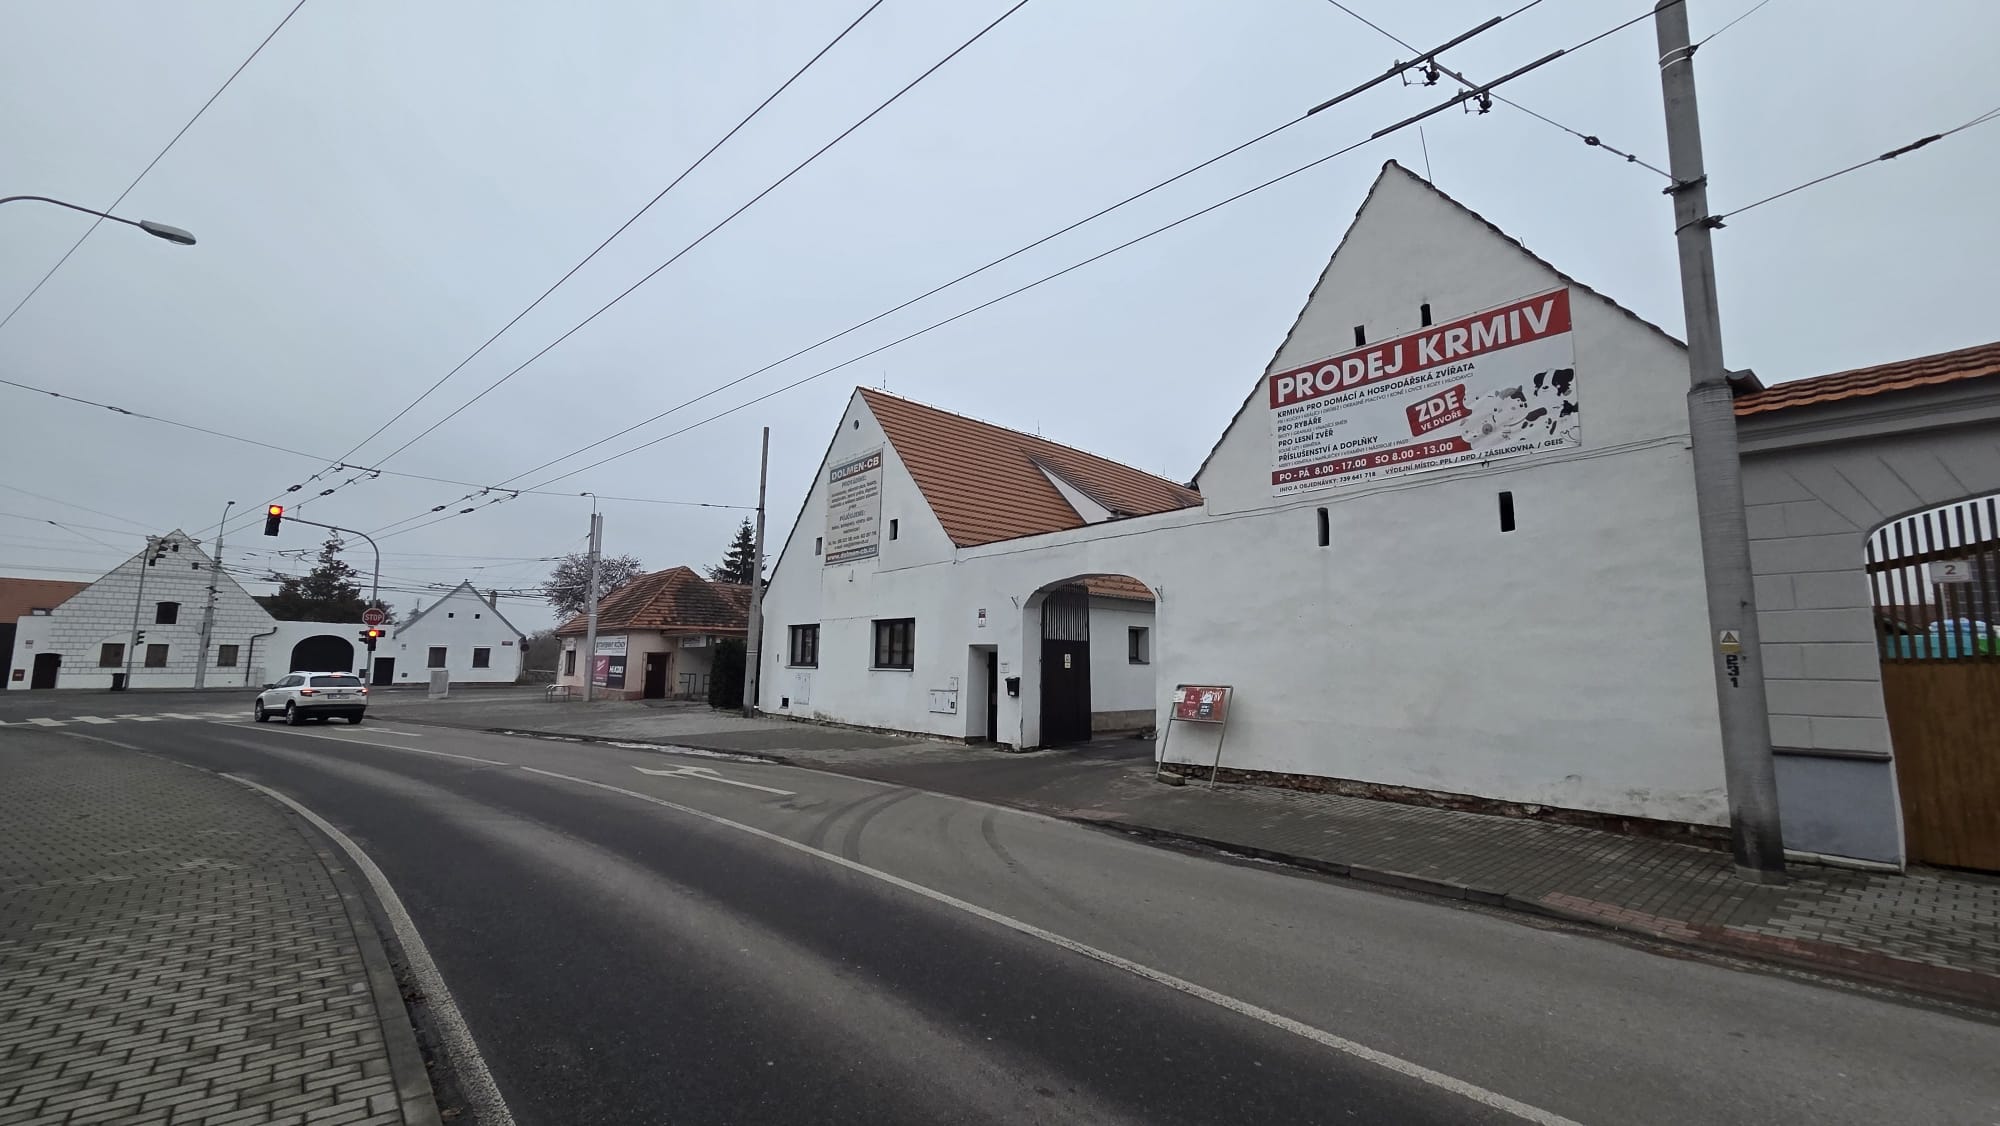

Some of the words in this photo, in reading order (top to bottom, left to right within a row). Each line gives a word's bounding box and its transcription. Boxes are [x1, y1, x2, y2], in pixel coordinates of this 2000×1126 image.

[1278, 344, 1403, 403] PRODEJ
[1418, 299, 1555, 366] KRMIV
[1277, 406, 1304, 418] KRMIVA
[1306, 401, 1321, 411] PRO
[1324, 391, 1356, 406] DOMÁCÍ
[1367, 372, 1433, 396] HOSPODÁŘSKÁ
[1435, 361, 1474, 378] ZVÍŘATA
[1416, 391, 1459, 422] ZDE
[1277, 423, 1292, 432] PRO
[1294, 416, 1321, 428] RYBÁŘE
[1421, 422, 1432, 431] VE
[1433, 410, 1462, 427] DVOŘE
[1278, 437, 1292, 447] PRO
[1294, 432, 1313, 443] LESNÍ
[1315, 428, 1333, 439] ZVĚŘ
[1278, 443, 1330, 462] PŘÍSLUŠENSTVÍ
[1332, 443, 1337, 451] A
[1340, 435, 1377, 450] DOPLŇKY
[1279, 472, 1291, 482] PO
[1298, 467, 1309, 478] PÁ
[1314, 464, 1333, 475] 8.00
[1341, 458, 1366, 470] 17.00
[1375, 453, 1389, 464] SO
[1391, 449, 1413, 461] 8.00
[1423, 441, 1453, 455] 13.00
[1385, 464, 1412, 474] VÝDEJNÍ
[1414, 459, 1438, 469] MÍSTO:
[1439, 457, 1451, 465] PPL
[1460, 453, 1475, 461] DPD
[1484, 441, 1534, 457] ZÁSILKOVNA
[1544, 438, 1563, 447] GEIS
[1944, 564, 1956, 576] 2
[364, 613, 382, 621] STOP
